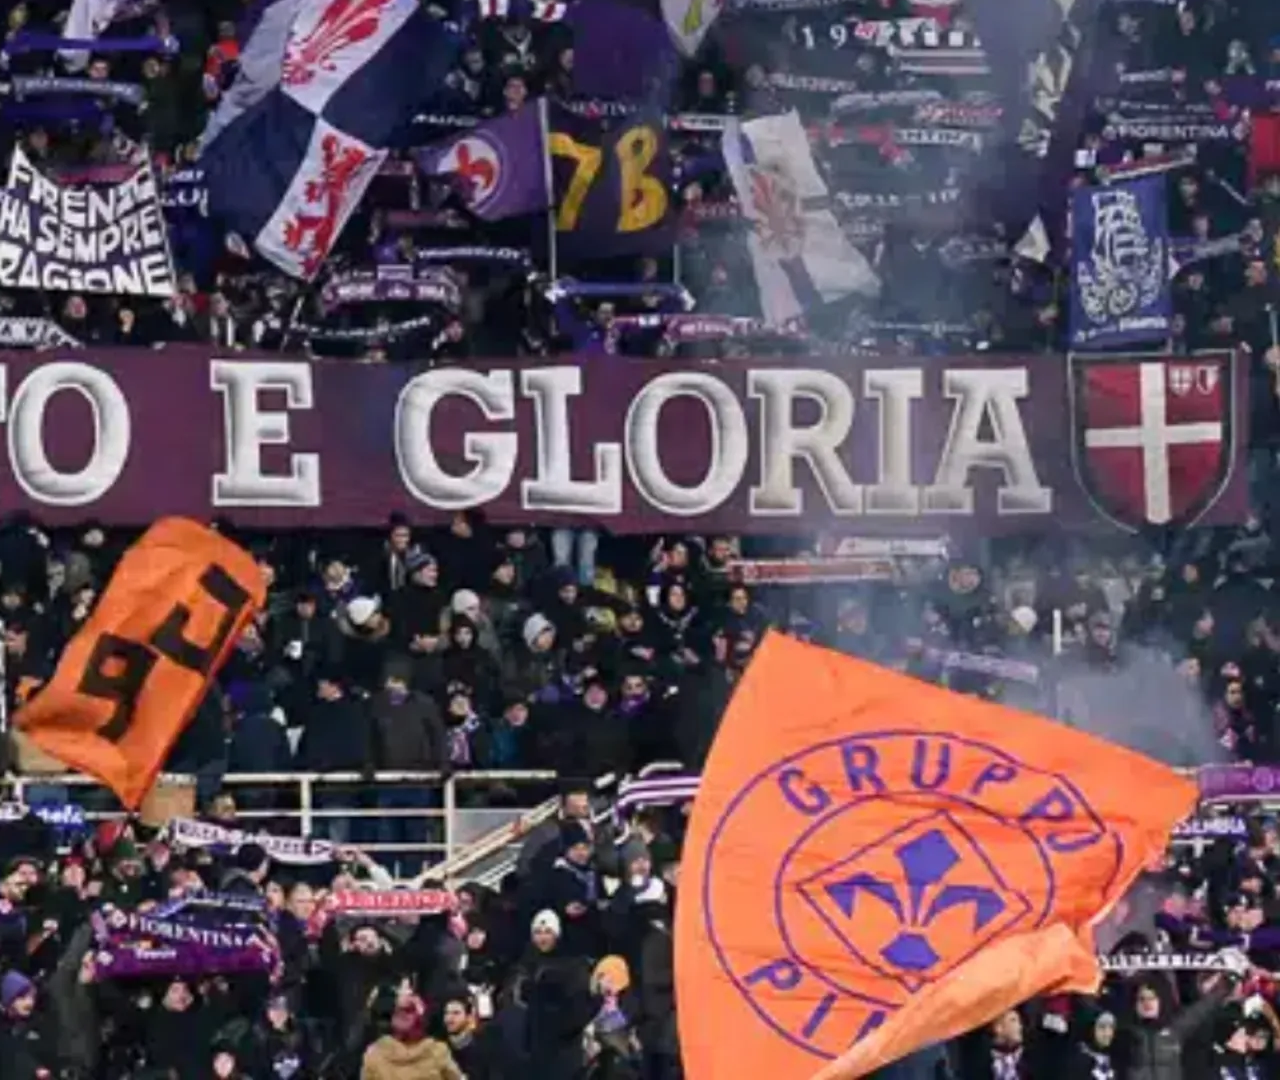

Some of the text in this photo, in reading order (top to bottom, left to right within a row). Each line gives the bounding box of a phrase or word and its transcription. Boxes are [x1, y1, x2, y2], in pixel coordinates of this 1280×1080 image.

[1116, 123, 1228, 141] FIORENTINA
[35, 204, 162, 264] SEMPRE
[209, 359, 321, 507] E
[394, 364, 1052, 516] GLORIA
[776, 736, 1104, 854] GRUPPO
